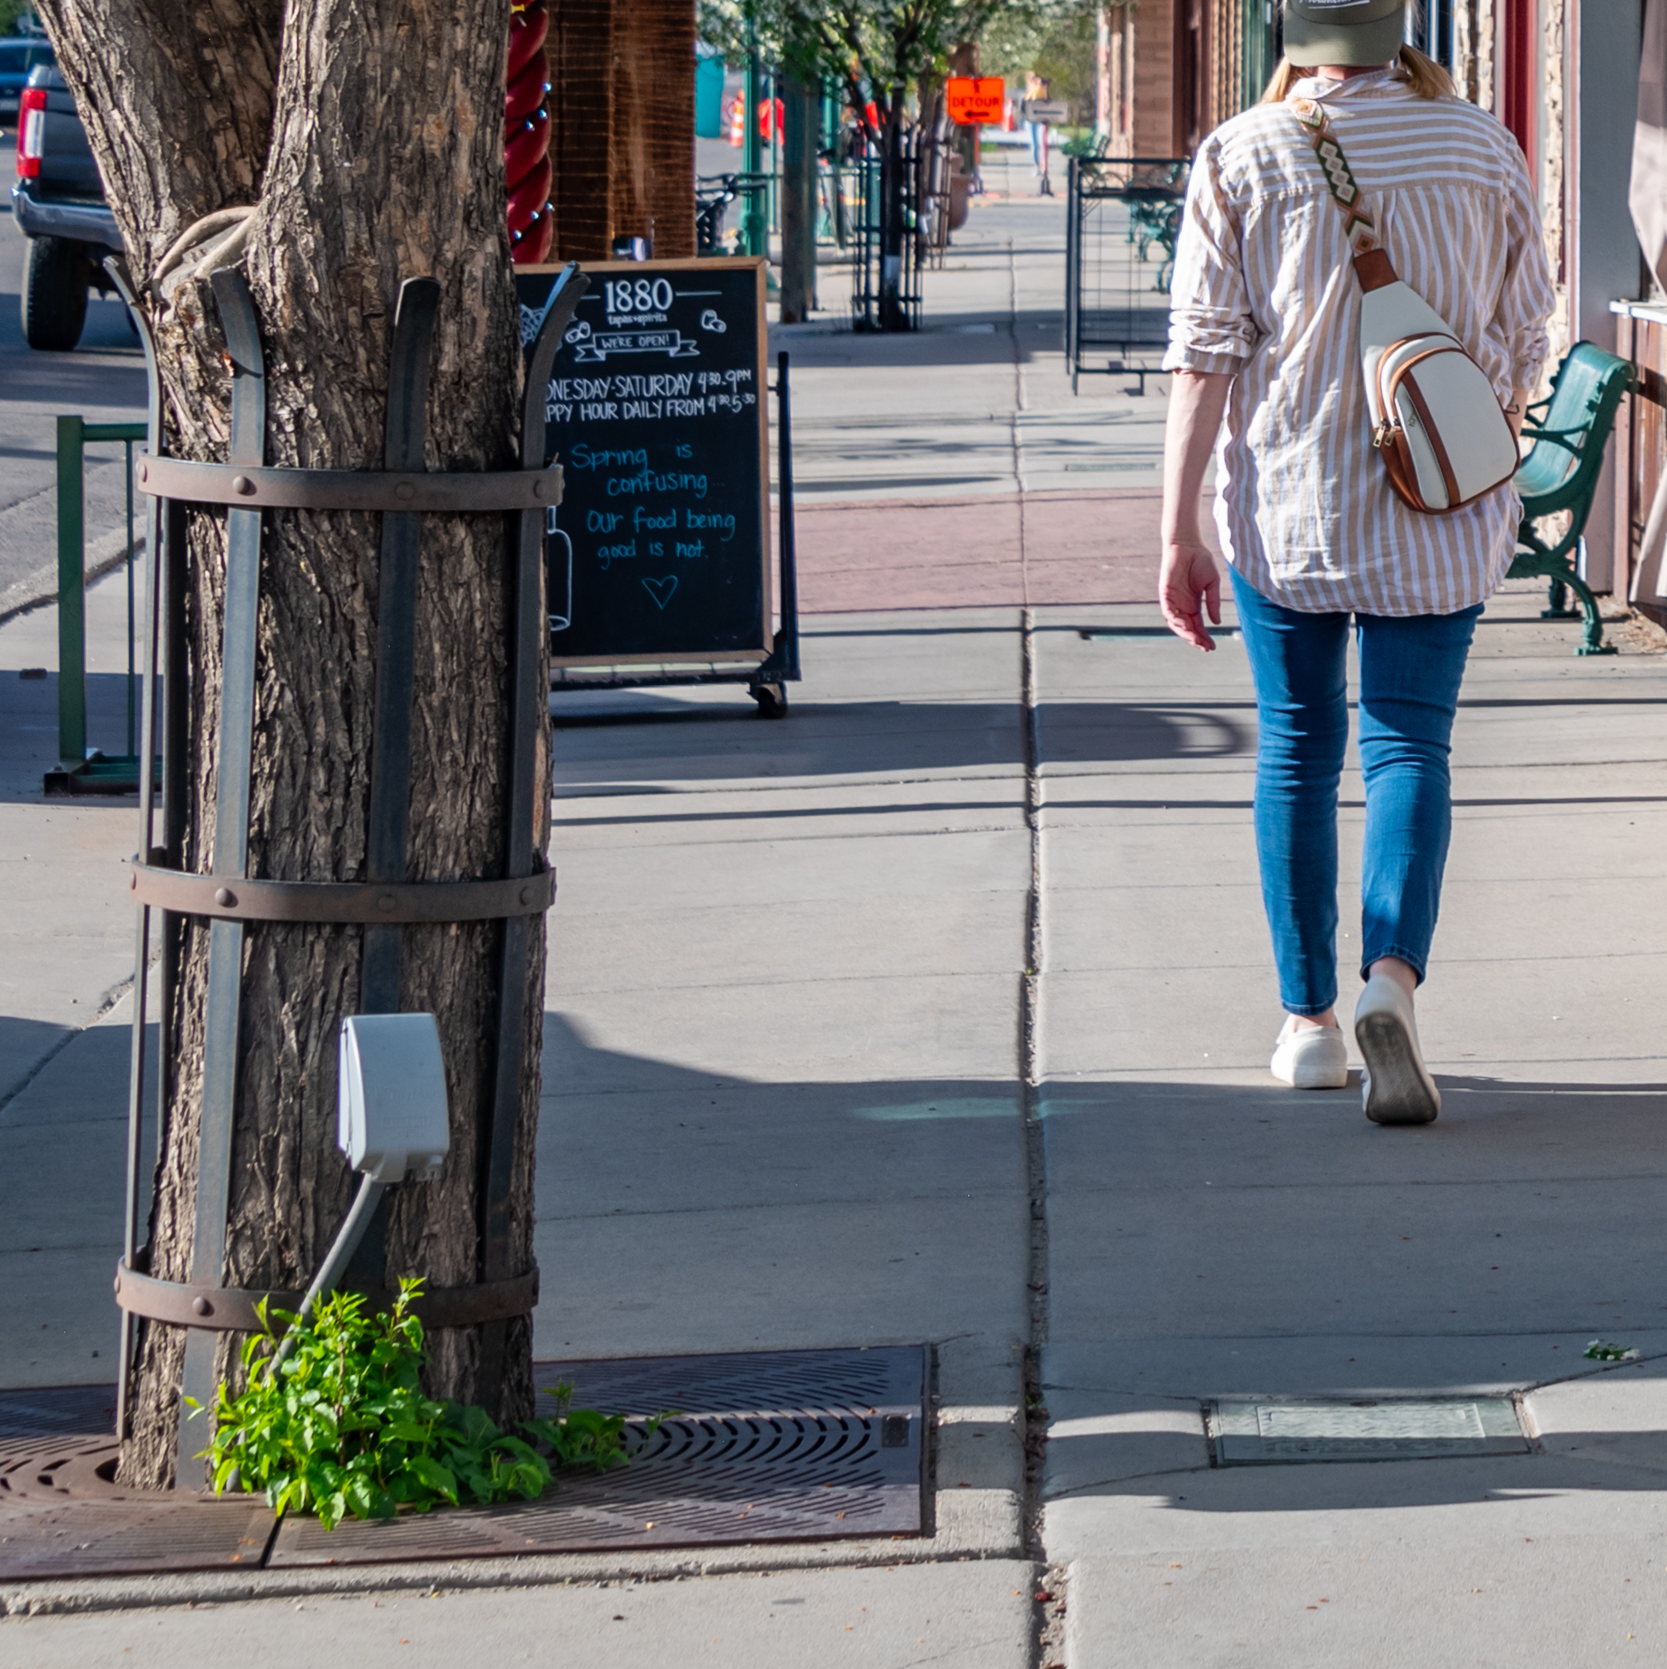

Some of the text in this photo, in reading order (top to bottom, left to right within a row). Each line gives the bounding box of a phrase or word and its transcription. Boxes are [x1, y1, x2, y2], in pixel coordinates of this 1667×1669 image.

[952, 97, 1000, 108] DETOUR
[604, 277, 674, 313] 1880
[638, 333, 670, 347] OPEN!
[544, 402, 574, 423] PPY
[580, 401, 619, 422] HOUR
[623, 398, 662, 419] DAILY
[666, 397, 705, 417] FROM
[571, 440, 693, 476] Spring is
[633, 505, 677, 533] food
[686, 507, 736, 542] being
[597, 537, 637, 571] good
[649, 541, 664, 557] is
